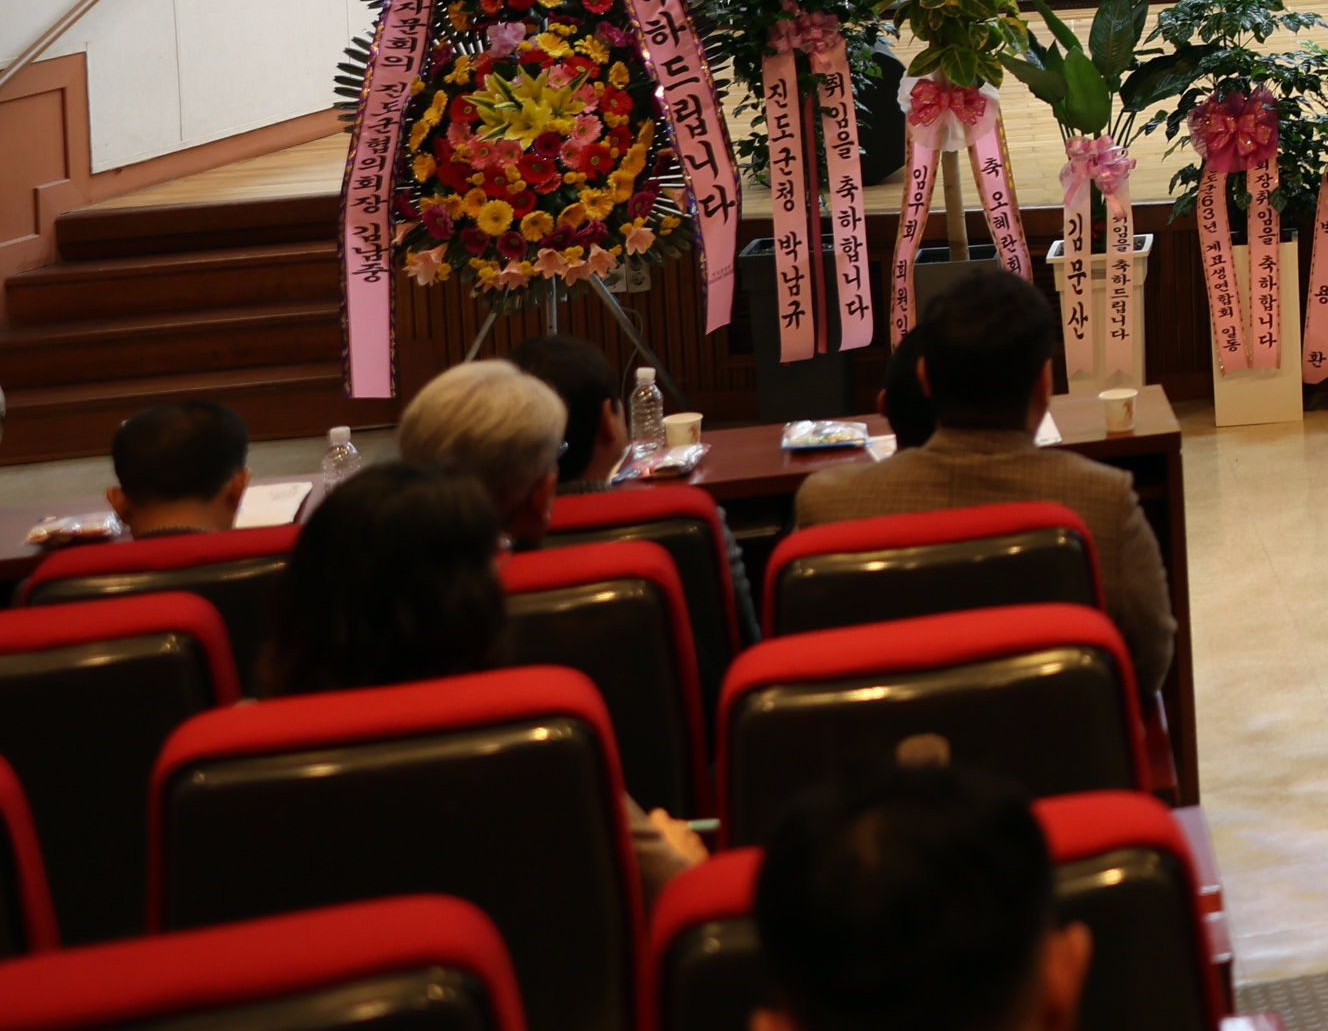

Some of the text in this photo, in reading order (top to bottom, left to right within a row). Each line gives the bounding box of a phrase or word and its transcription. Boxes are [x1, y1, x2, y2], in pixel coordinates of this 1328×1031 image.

[350, 81, 409, 215] 진도군협의회장
[824, 72, 871, 321] 취임을 축하합니다
[903, 164, 929, 243] 임우회
[981, 157, 1003, 178] 축
[351, 222, 390, 283] 김남중
[767, 78, 806, 331] 진도군청 박남규
[1067, 213, 1089, 340] 김문산
[1111, 258, 1130, 341] 축하드립니다
[1200, 170, 1242, 352] 도군63년 계묘생연합회 일동
[1257, 254, 1279, 350] 축하합니다
